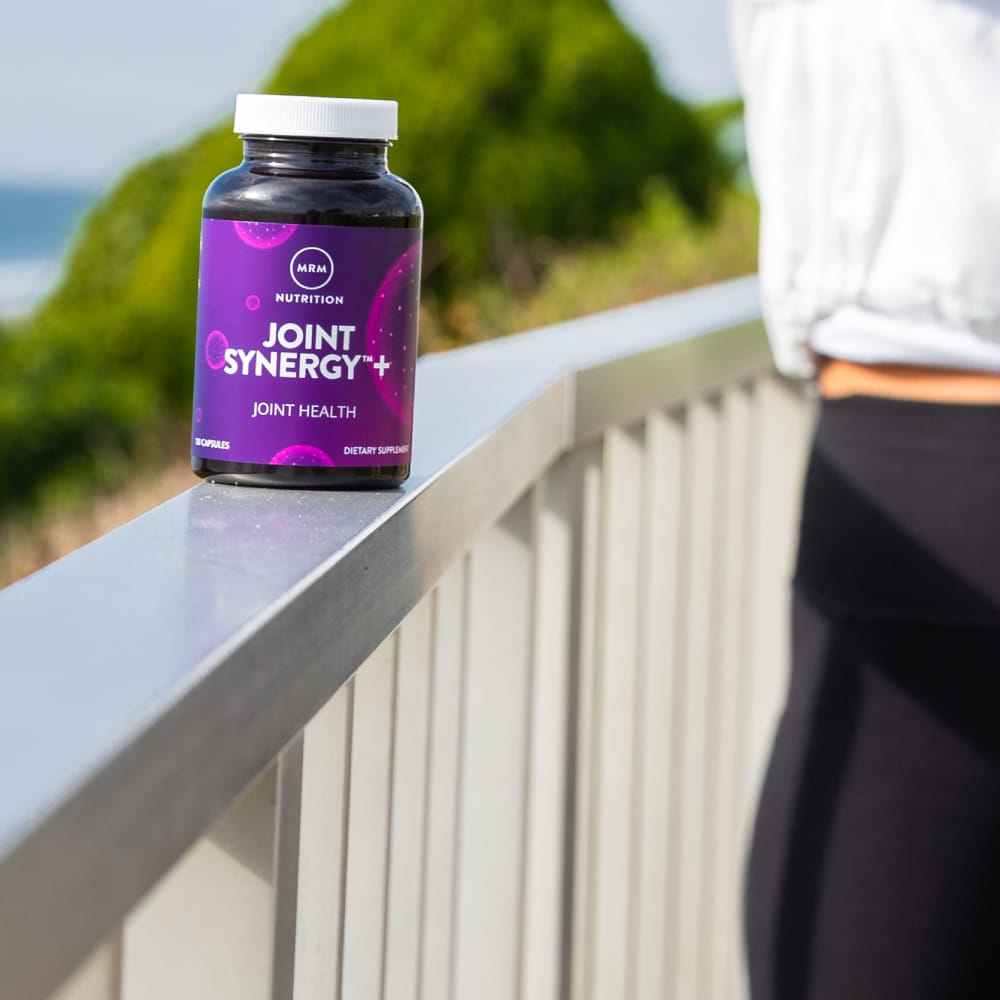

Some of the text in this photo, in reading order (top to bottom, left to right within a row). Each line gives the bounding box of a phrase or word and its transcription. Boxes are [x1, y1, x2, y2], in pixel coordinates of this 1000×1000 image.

[296, 263, 327, 273] MRM
[275, 293, 343, 305] NUTRITION
[262, 322, 356, 350] JOINT
[251, 402, 356, 418] JOINT HEALTH
[344, 446, 376, 455] DIETARY
